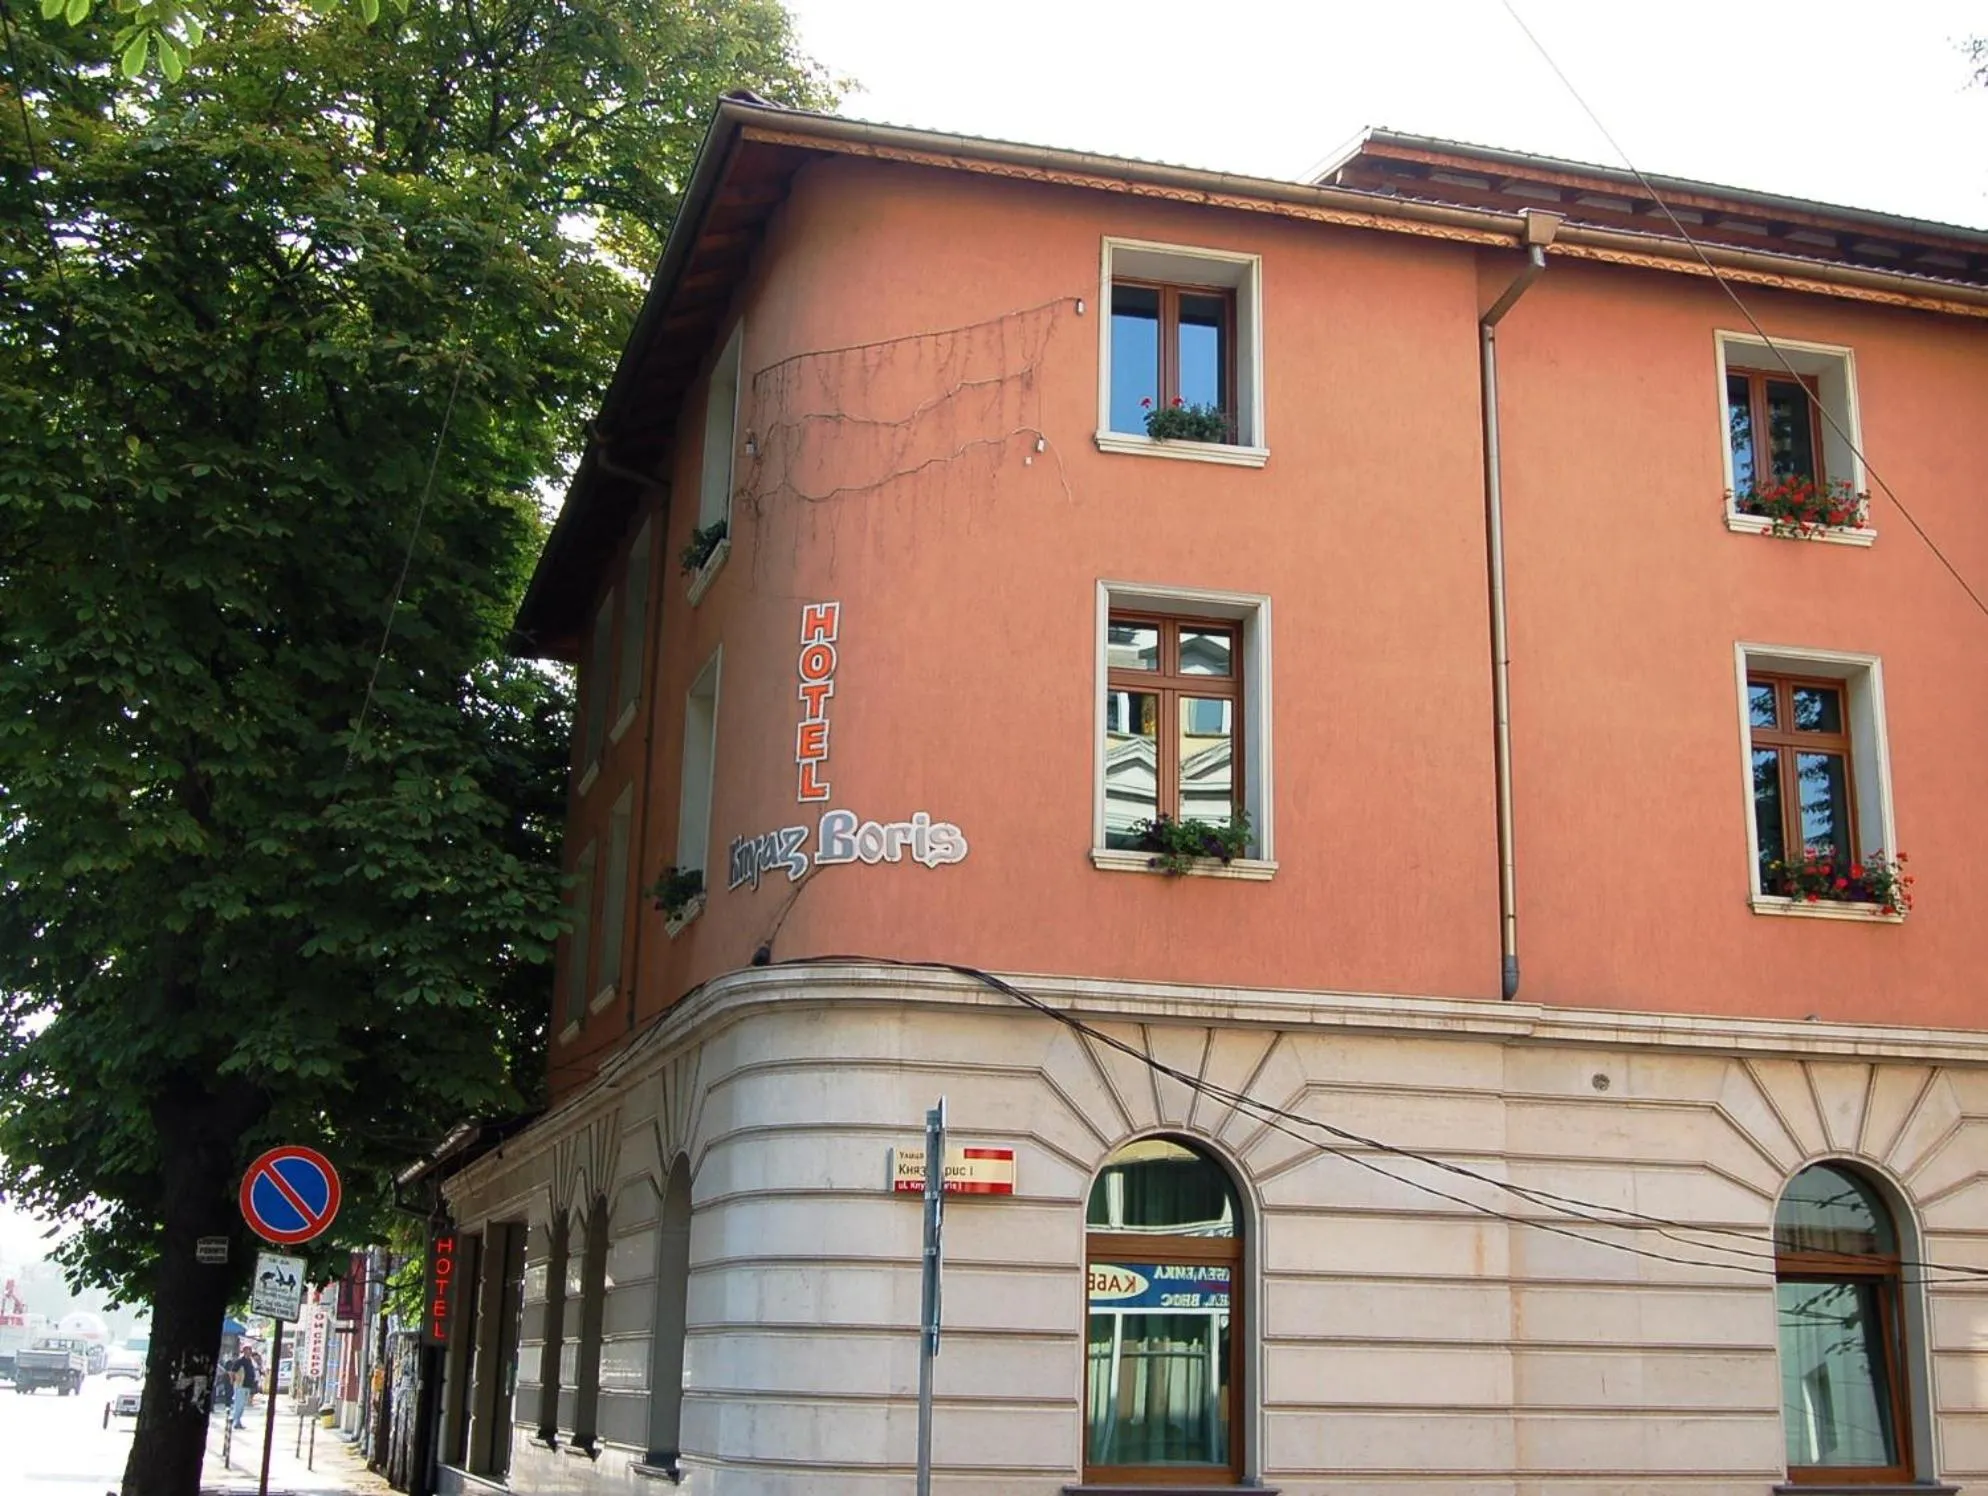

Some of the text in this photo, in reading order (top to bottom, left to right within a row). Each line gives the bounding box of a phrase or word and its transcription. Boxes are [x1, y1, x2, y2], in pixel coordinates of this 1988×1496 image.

[797, 602, 840, 802] HOTEL
[815, 810, 968, 869] Boris
[944, 1166, 967, 1177] рис
[434, 1237, 453, 1338] HOTEL
